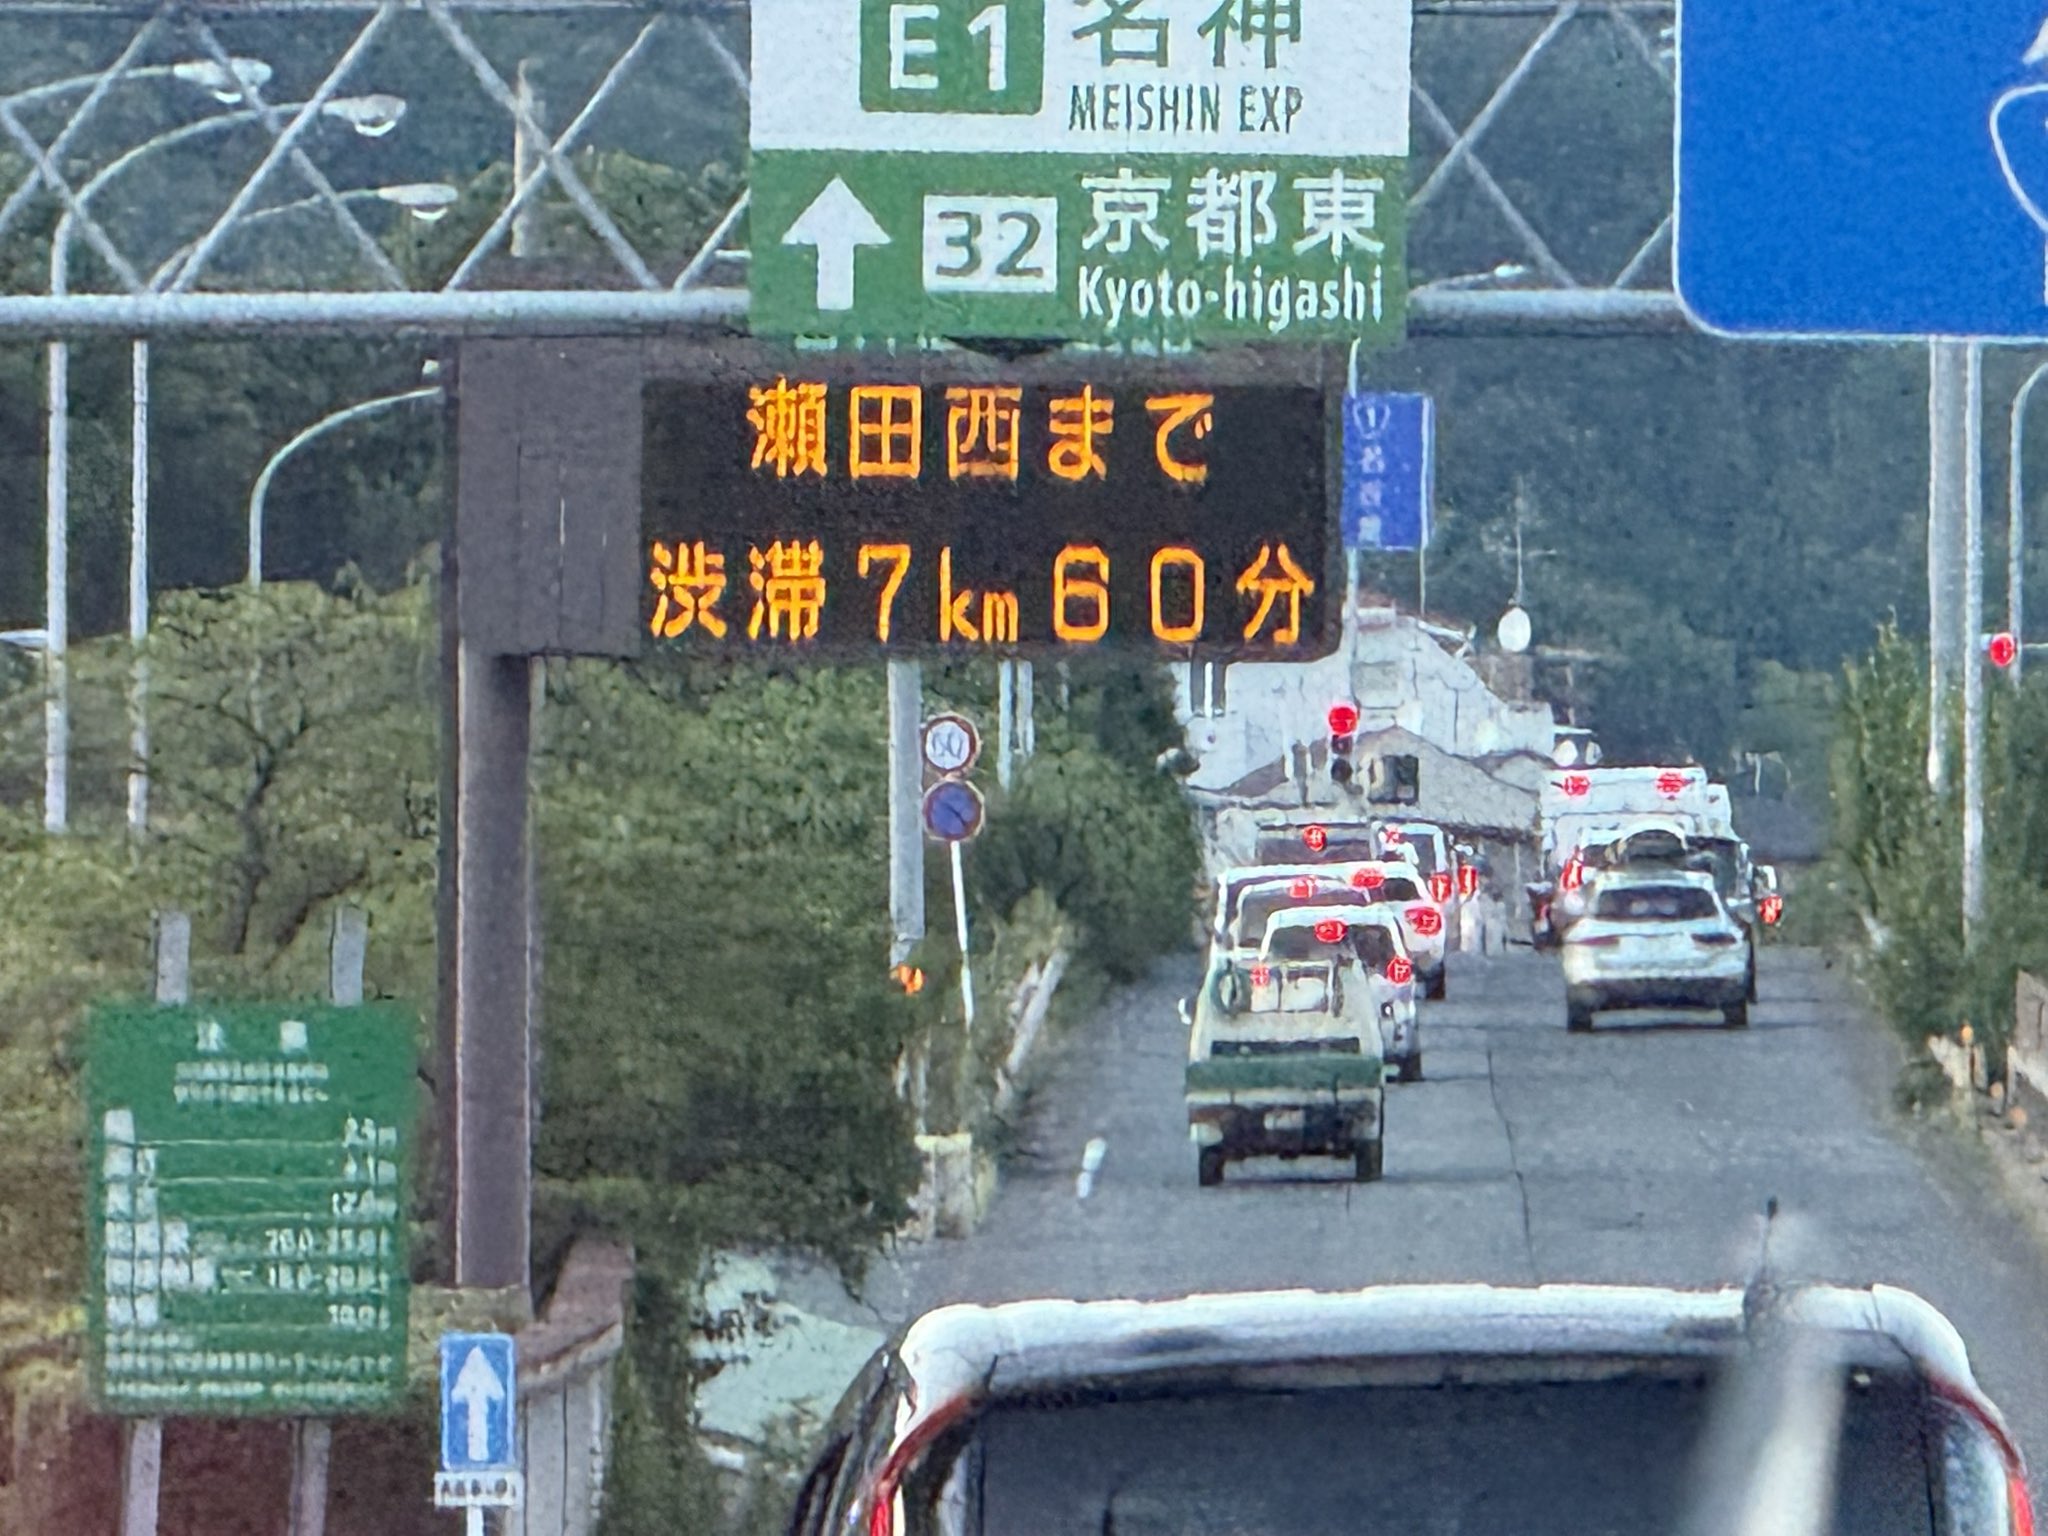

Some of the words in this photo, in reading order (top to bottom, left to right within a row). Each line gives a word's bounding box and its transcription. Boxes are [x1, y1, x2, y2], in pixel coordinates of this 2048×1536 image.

[889, 3, 1007, 91] E1
[1069, 84, 1220, 133] MEISHIN
[1239, 84, 1303, 134] EXP
[935, 210, 1044, 278] 32
[1080, 167, 1386, 263] 京都東
[1078, 265, 1383, 330] Kyoto-higashi
[746, 377, 1214, 483] 瀬田西まで
